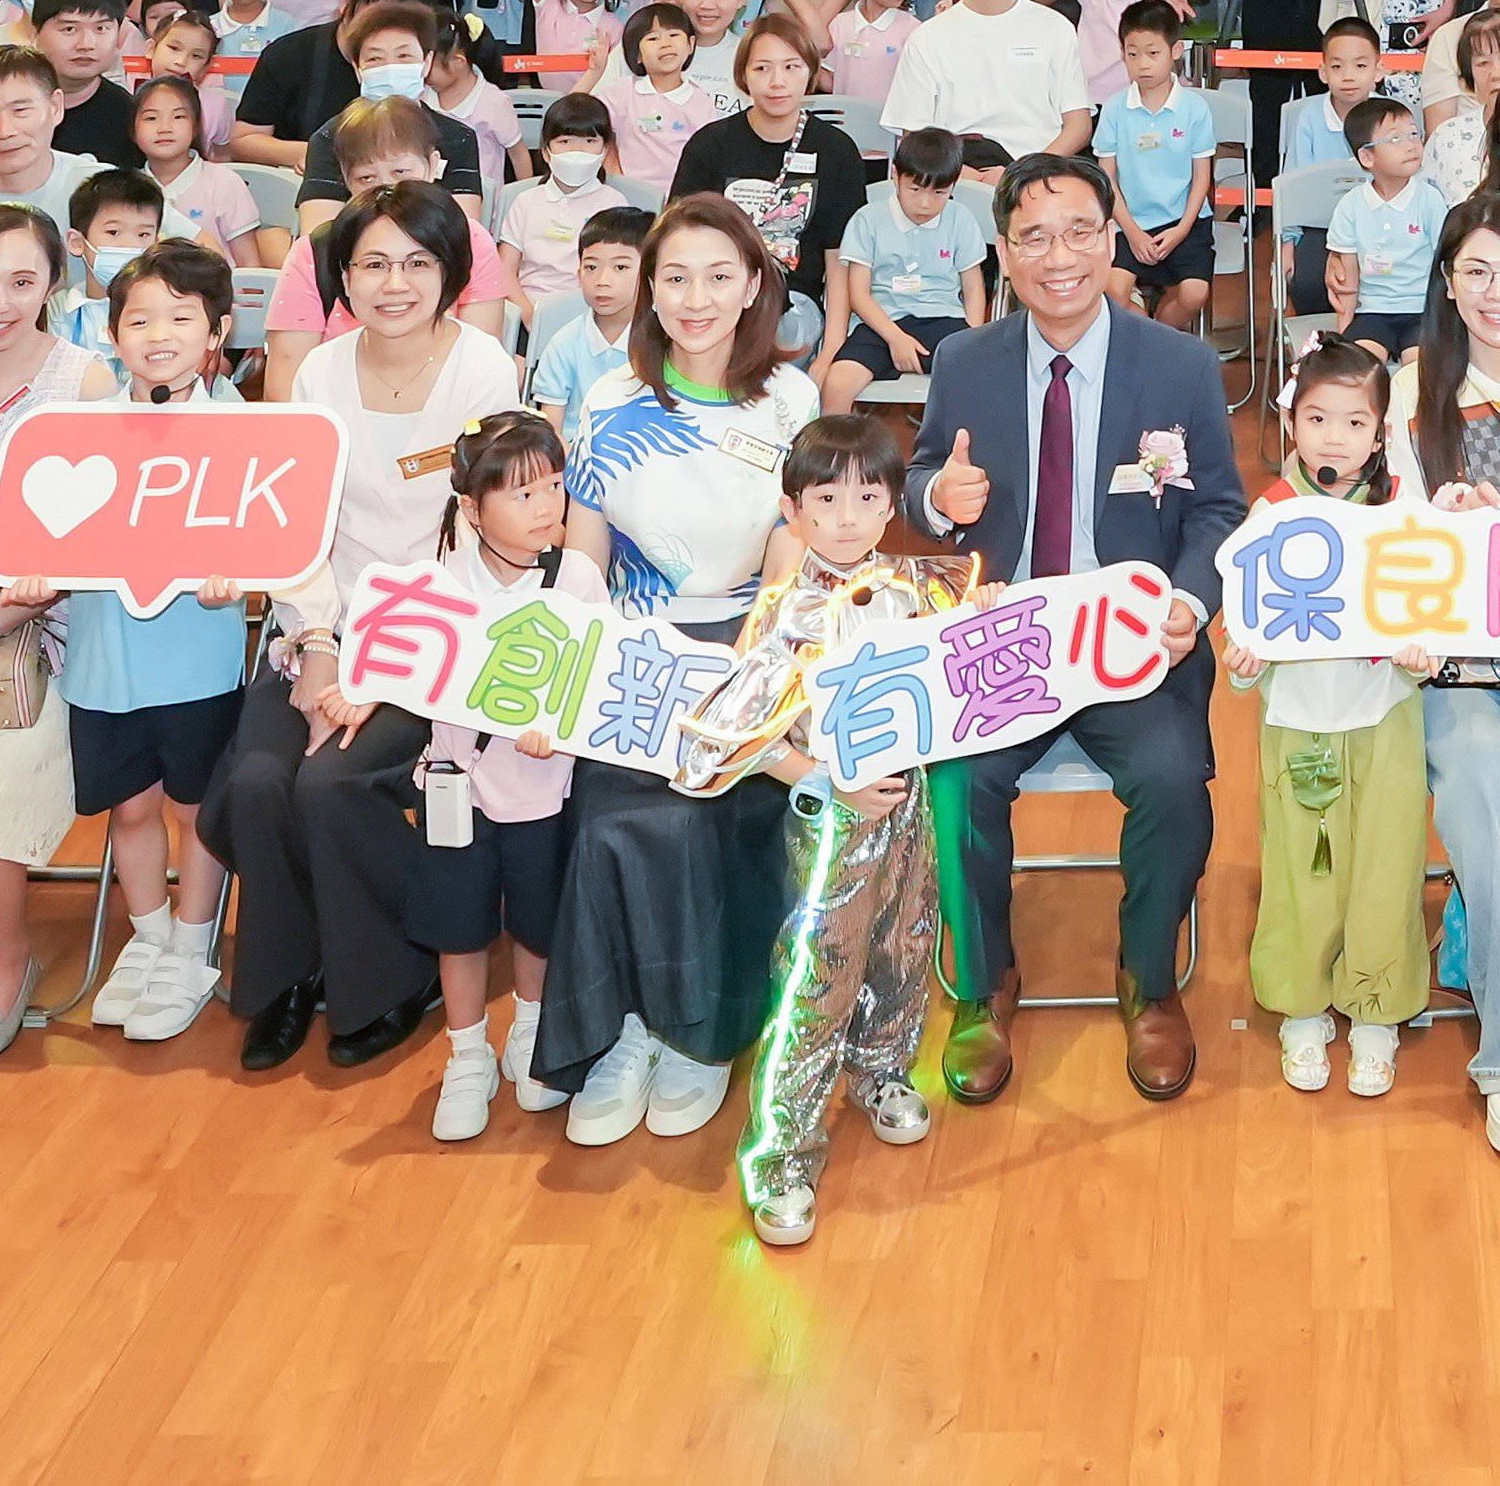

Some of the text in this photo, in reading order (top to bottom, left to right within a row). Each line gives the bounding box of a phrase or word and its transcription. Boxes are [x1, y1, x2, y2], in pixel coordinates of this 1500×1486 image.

[129, 456, 297, 529] PLK
[350, 572, 1164, 780] 有創新 有愛心
